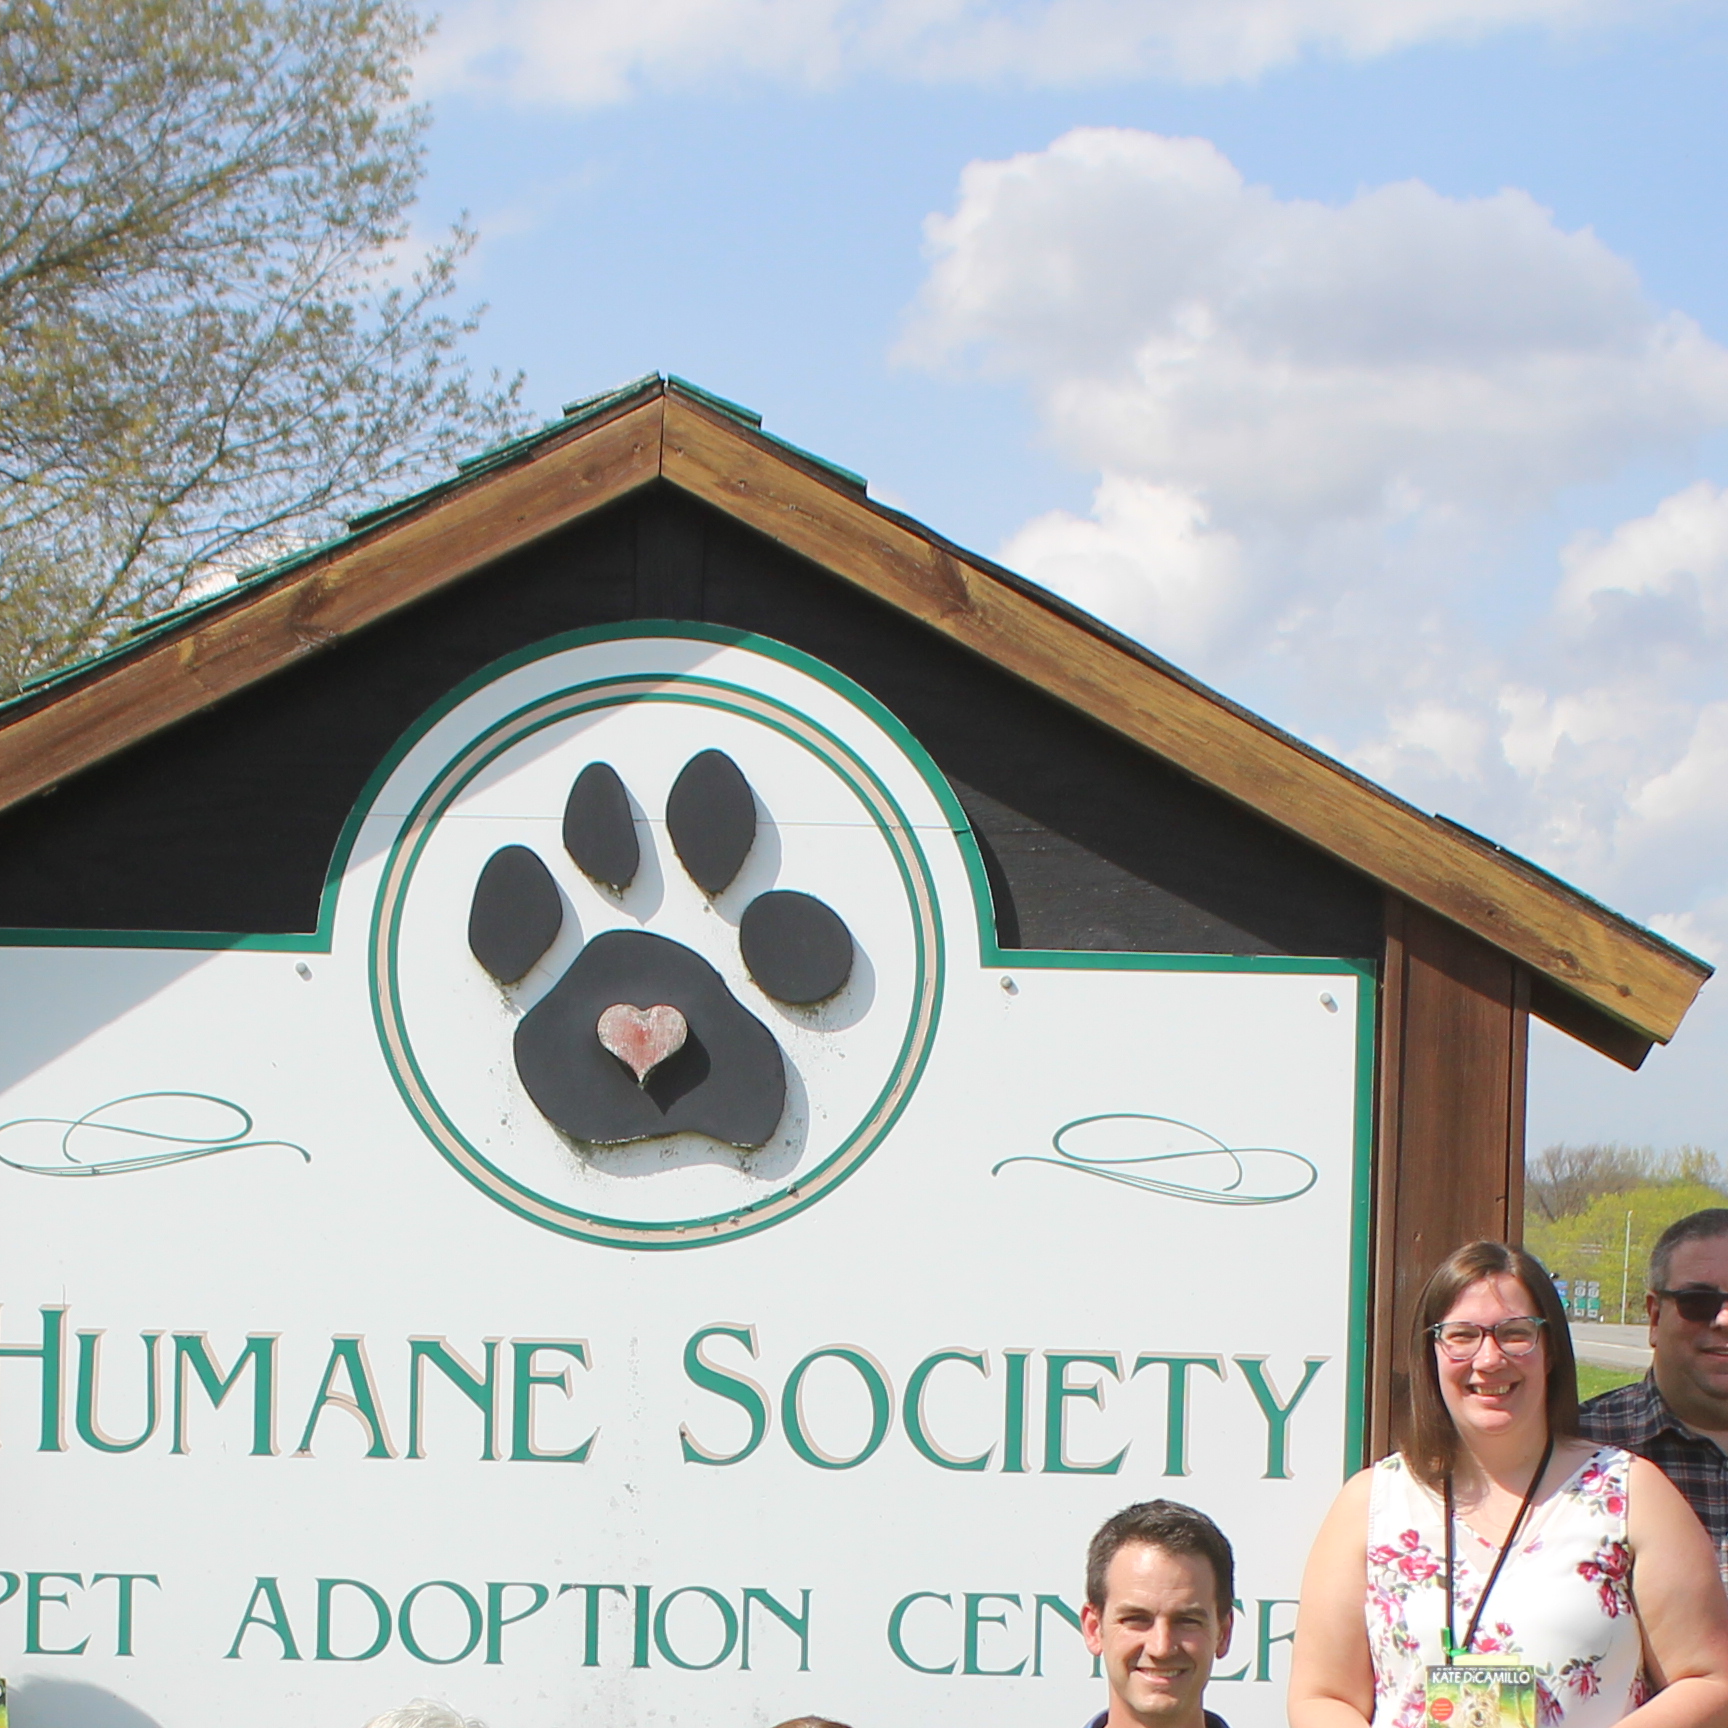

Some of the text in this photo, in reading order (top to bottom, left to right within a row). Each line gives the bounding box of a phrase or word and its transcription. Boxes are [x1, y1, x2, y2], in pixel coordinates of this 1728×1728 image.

[678, 1321, 1332, 1481] SOCIETY
[223, 1576, 812, 1672] ADOPTION
[1432, 1671, 1460, 1684] KATE
